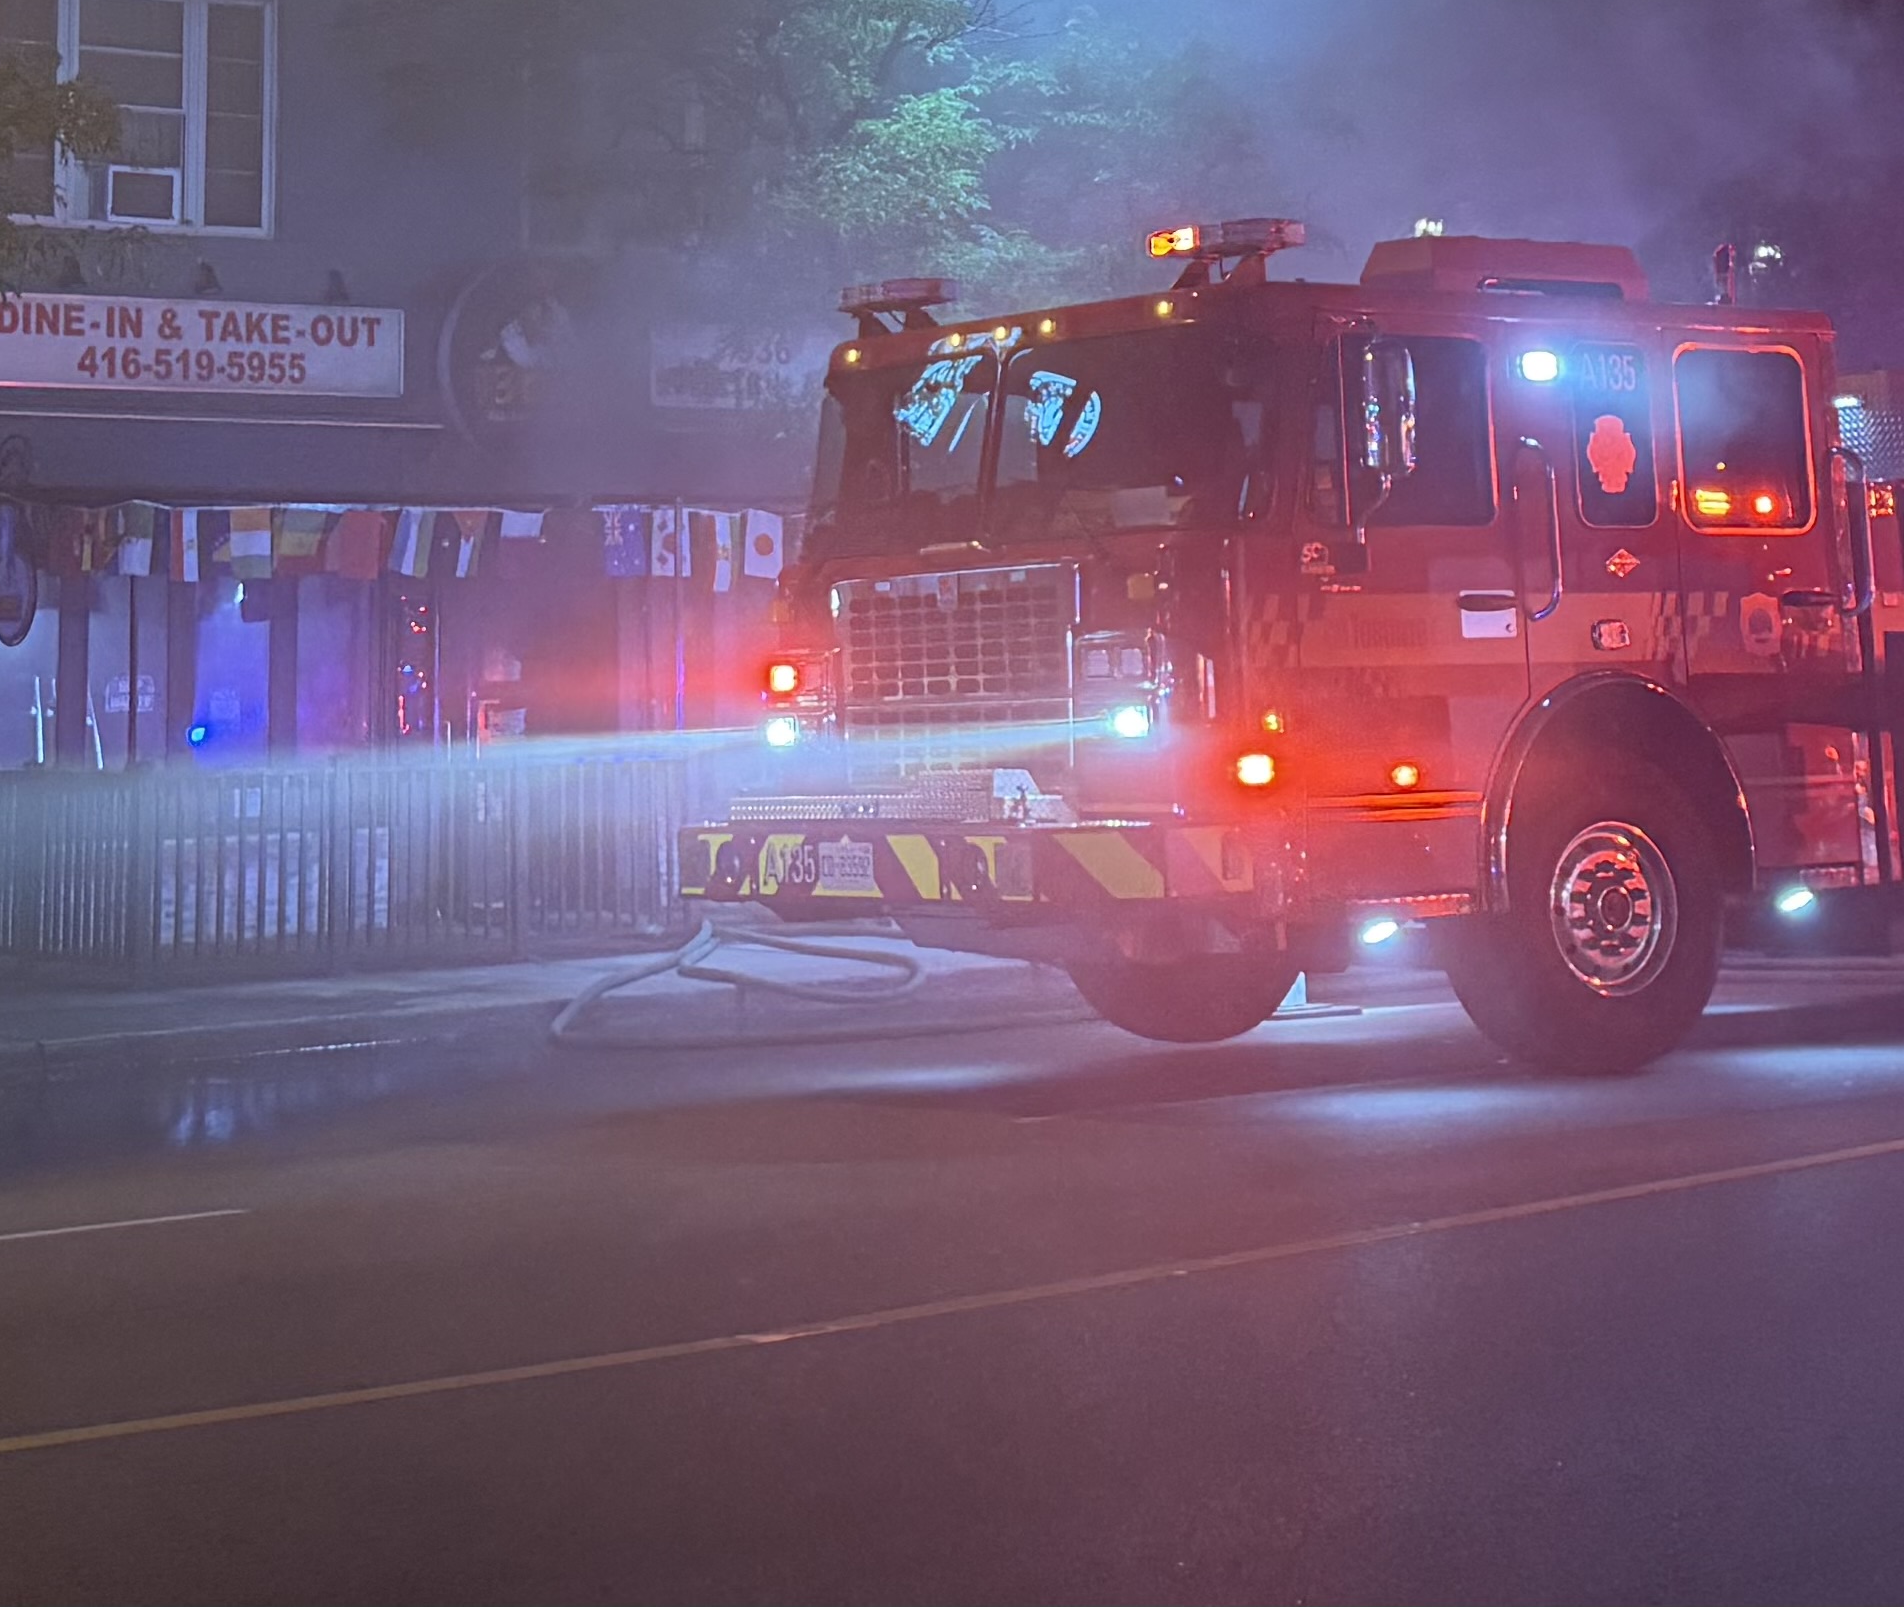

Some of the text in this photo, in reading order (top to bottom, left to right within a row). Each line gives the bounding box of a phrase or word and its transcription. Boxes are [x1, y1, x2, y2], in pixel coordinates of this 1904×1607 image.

[157, 308, 184, 342] &
[197, 310, 382, 348] TAKE-OUT
[77, 345, 307, 385] 416-519-5955
[1582, 352, 1637, 390] A135
[764, 843, 816, 884] A135
